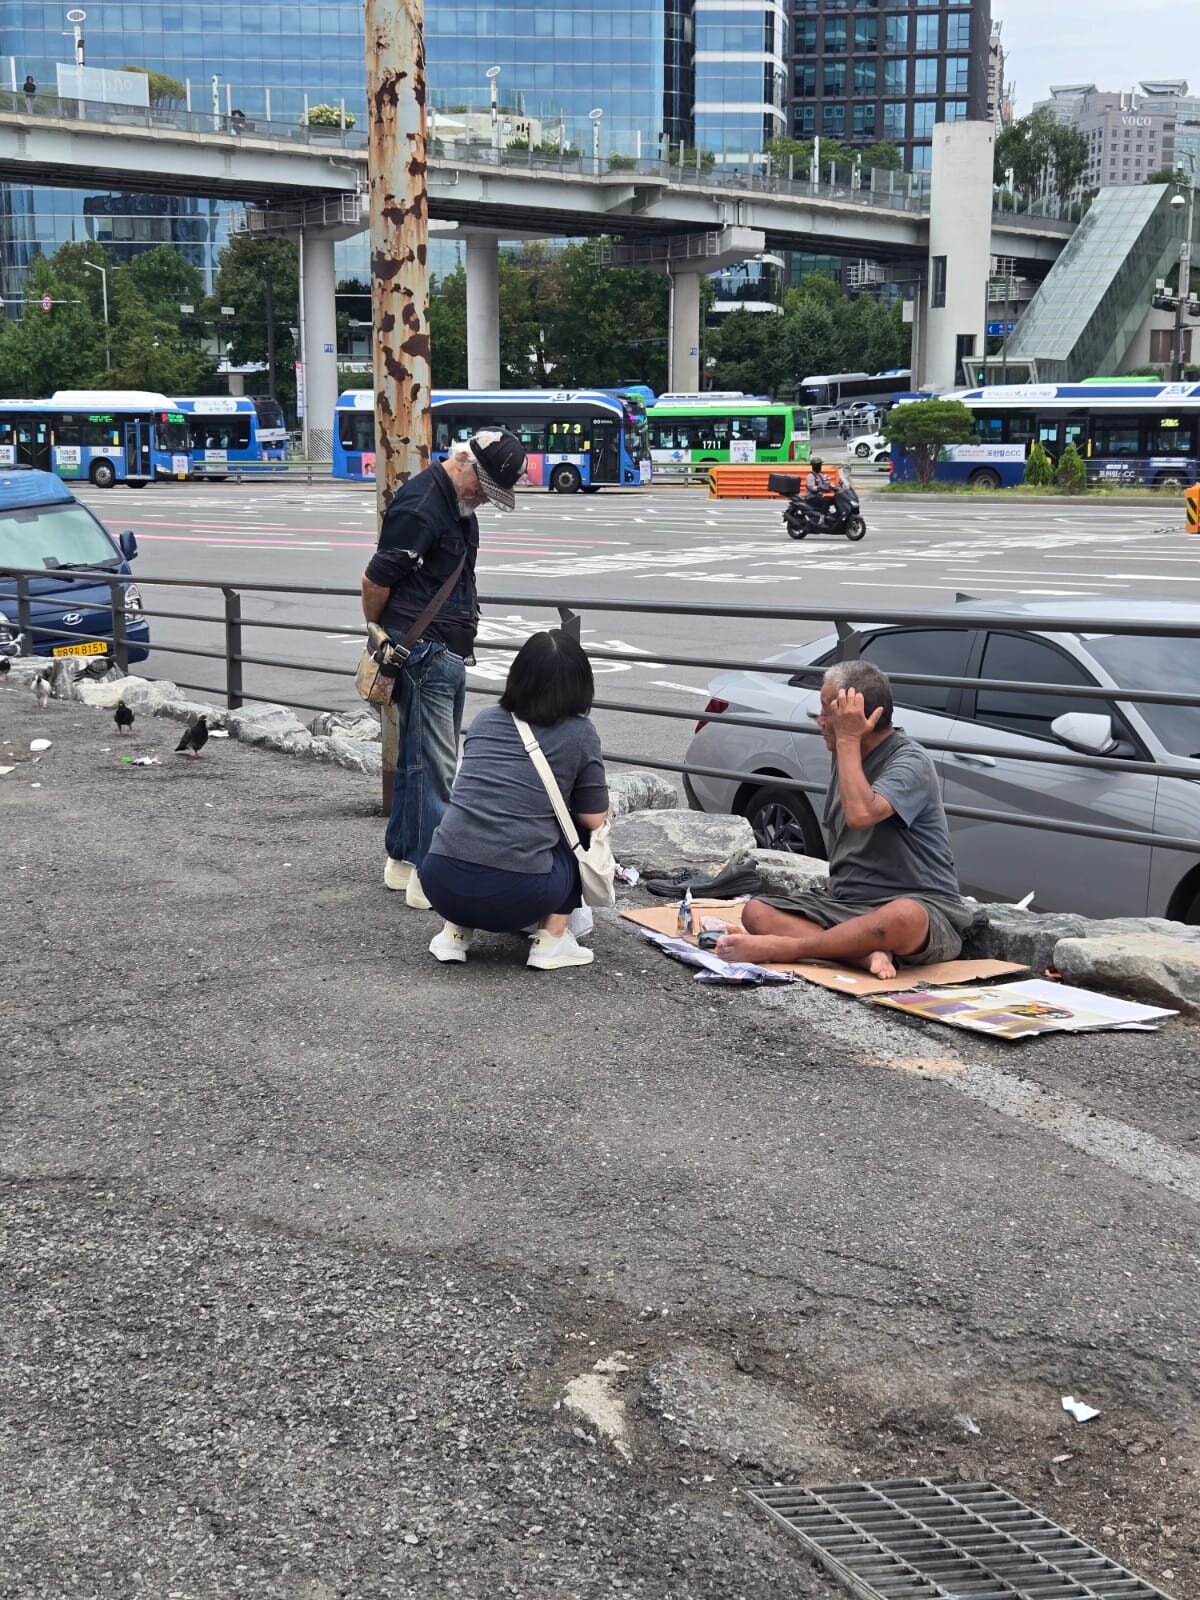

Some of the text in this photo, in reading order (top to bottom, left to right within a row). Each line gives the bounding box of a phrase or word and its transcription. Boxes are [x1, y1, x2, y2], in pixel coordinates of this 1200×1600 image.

[551, 423, 581, 434] 173
[702, 440, 721, 449] 1711
[82, 642, 103, 655] 8151
